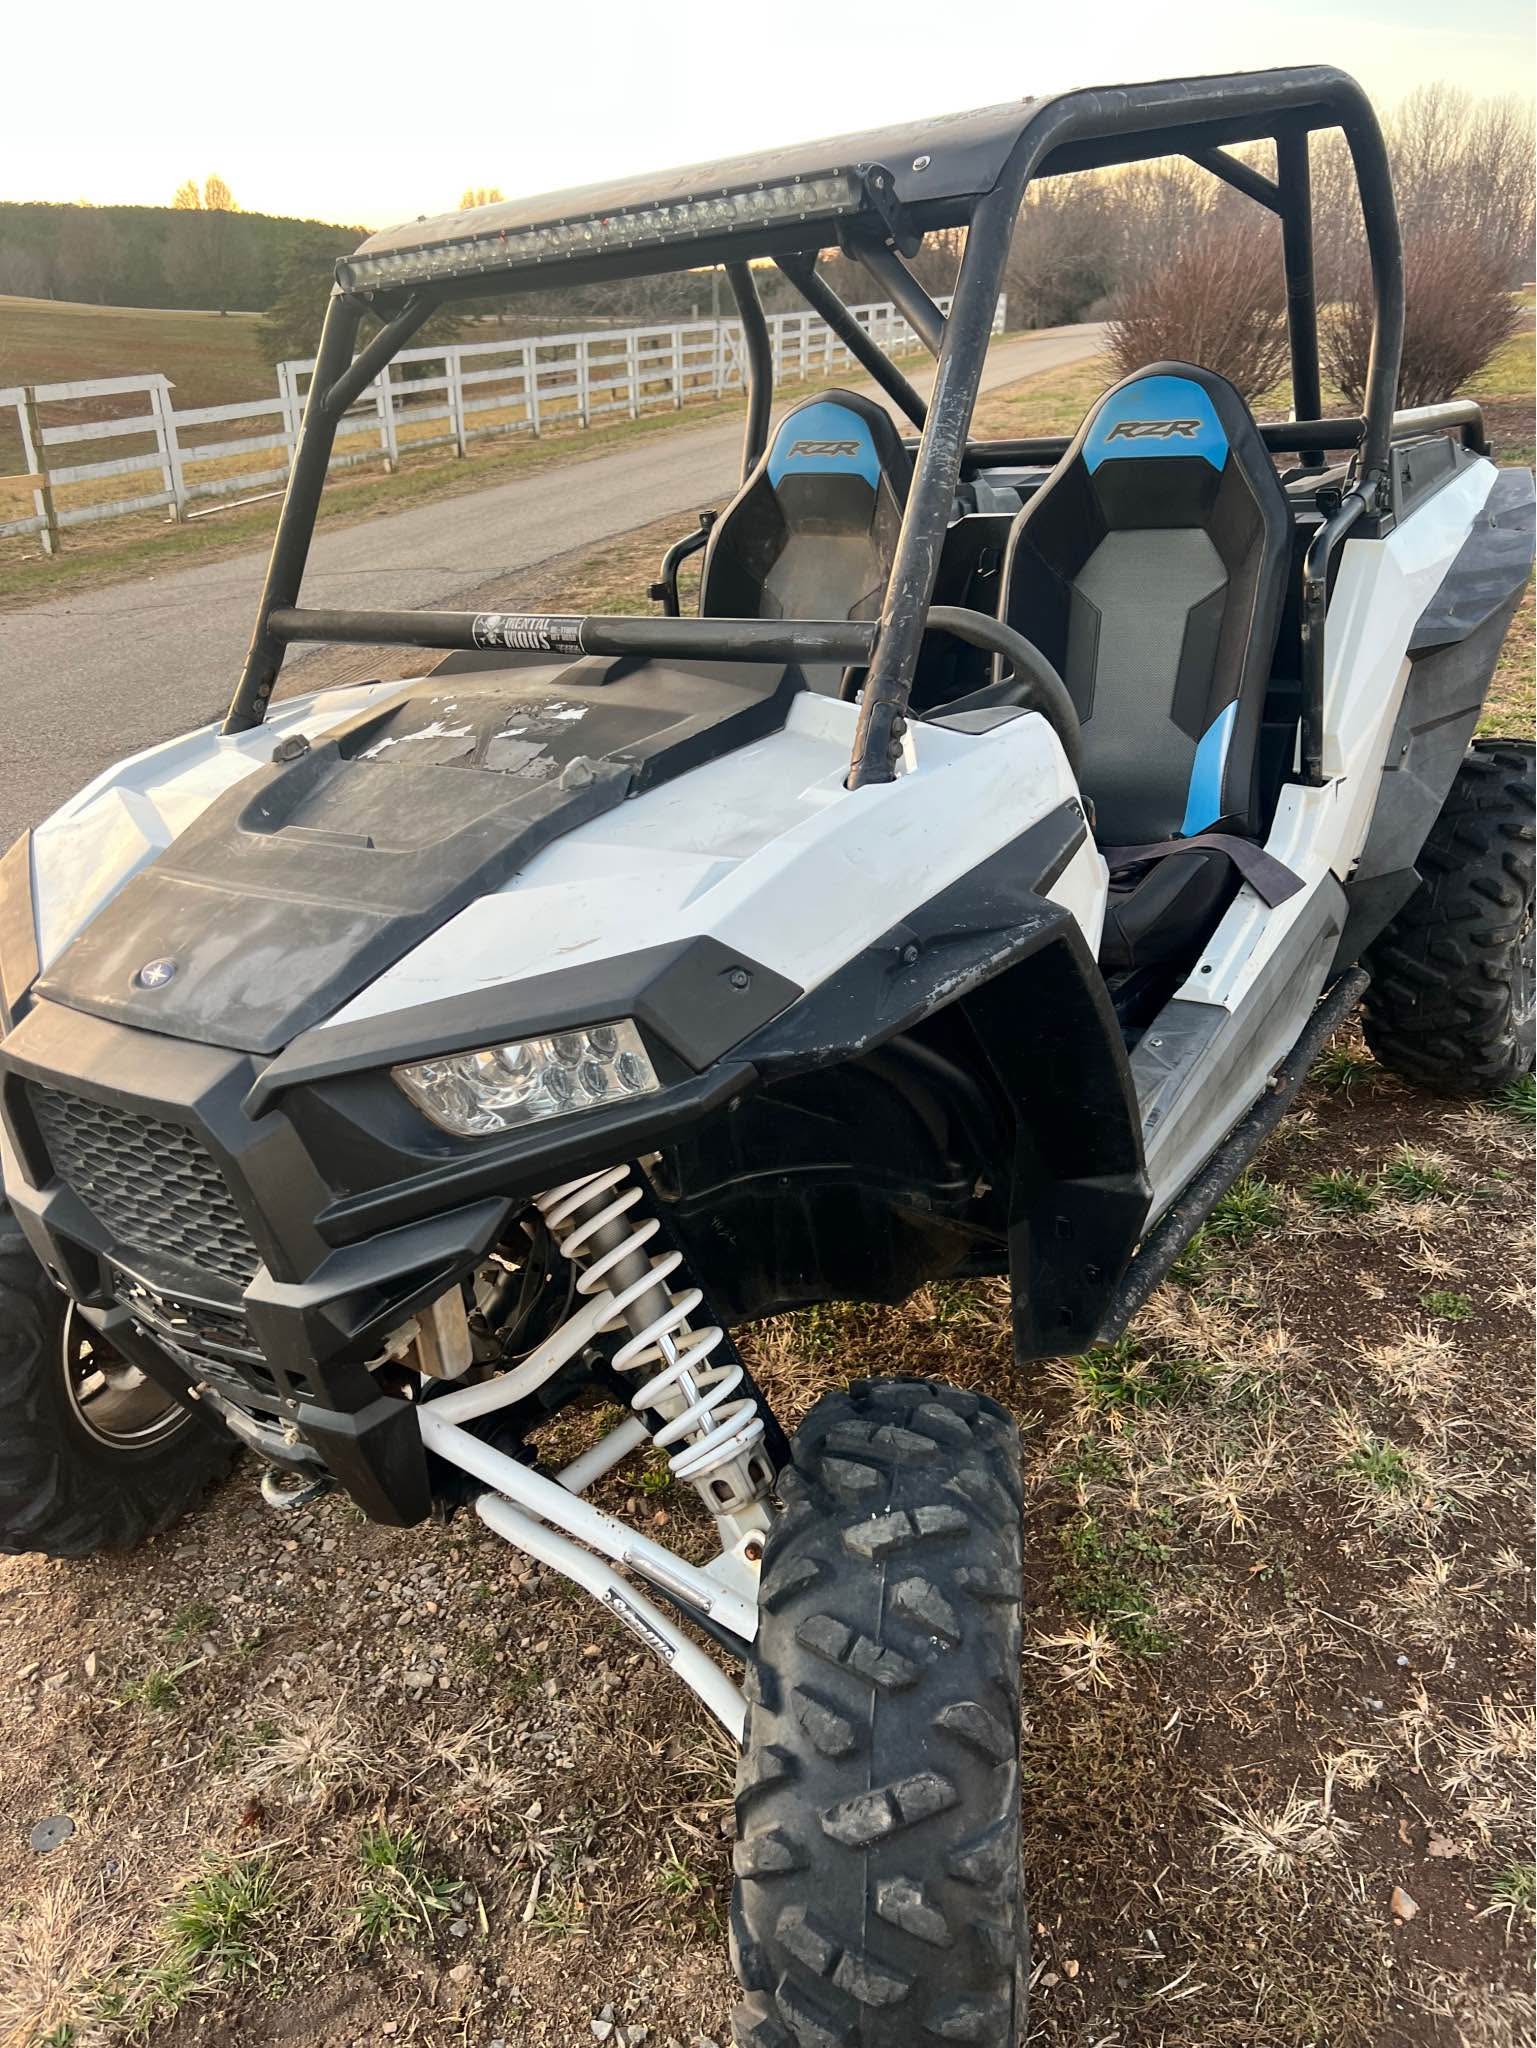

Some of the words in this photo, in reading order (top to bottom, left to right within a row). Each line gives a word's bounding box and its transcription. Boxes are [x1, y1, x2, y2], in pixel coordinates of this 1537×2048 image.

[1105, 419, 1201, 442] RZR
[787, 440, 862, 458] RZR
[505, 617, 550, 630] MENTAL
[504, 630, 550, 650] MODS
